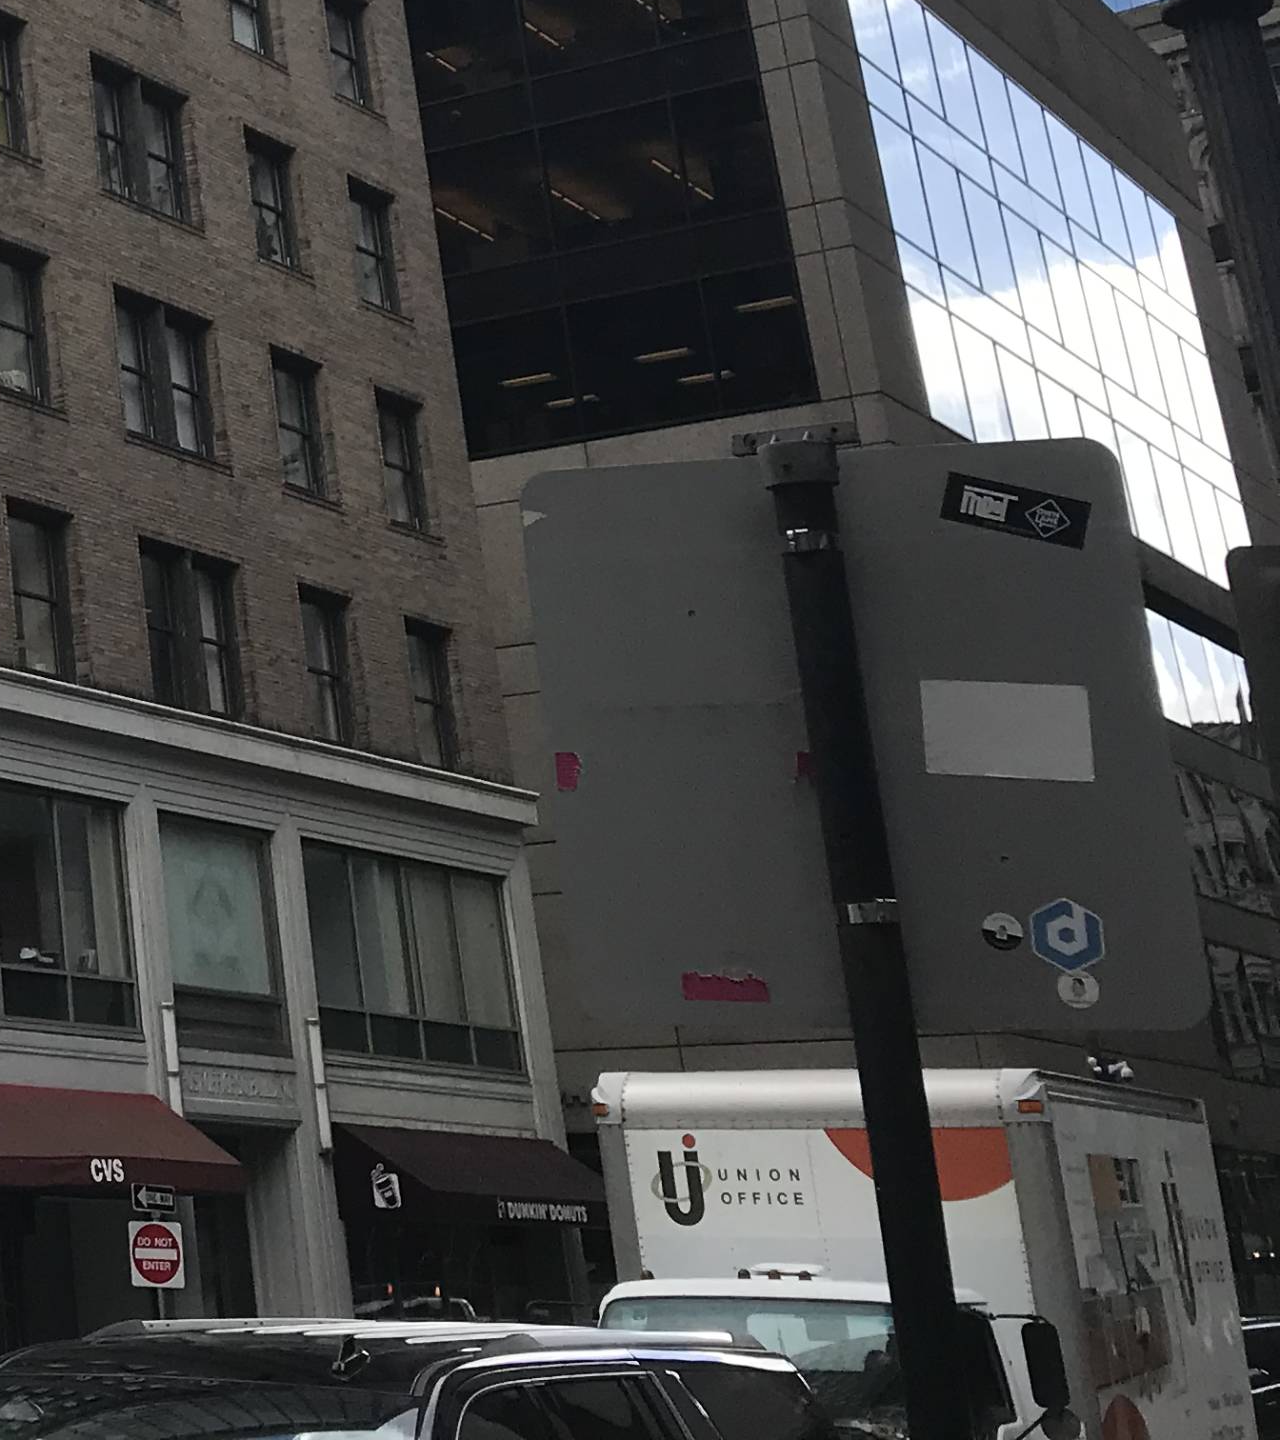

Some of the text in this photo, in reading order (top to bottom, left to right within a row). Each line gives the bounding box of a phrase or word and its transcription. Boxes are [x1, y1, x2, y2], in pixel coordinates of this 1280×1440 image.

[90, 1158, 125, 1182] CVS
[717, 1168, 801, 1182] UNION
[720, 1191, 805, 1206] OFFICE
[549, 1204, 588, 1223] DONUTS
[137, 1237, 173, 1248] DO NOT
[142, 1261, 172, 1272] ENTER
